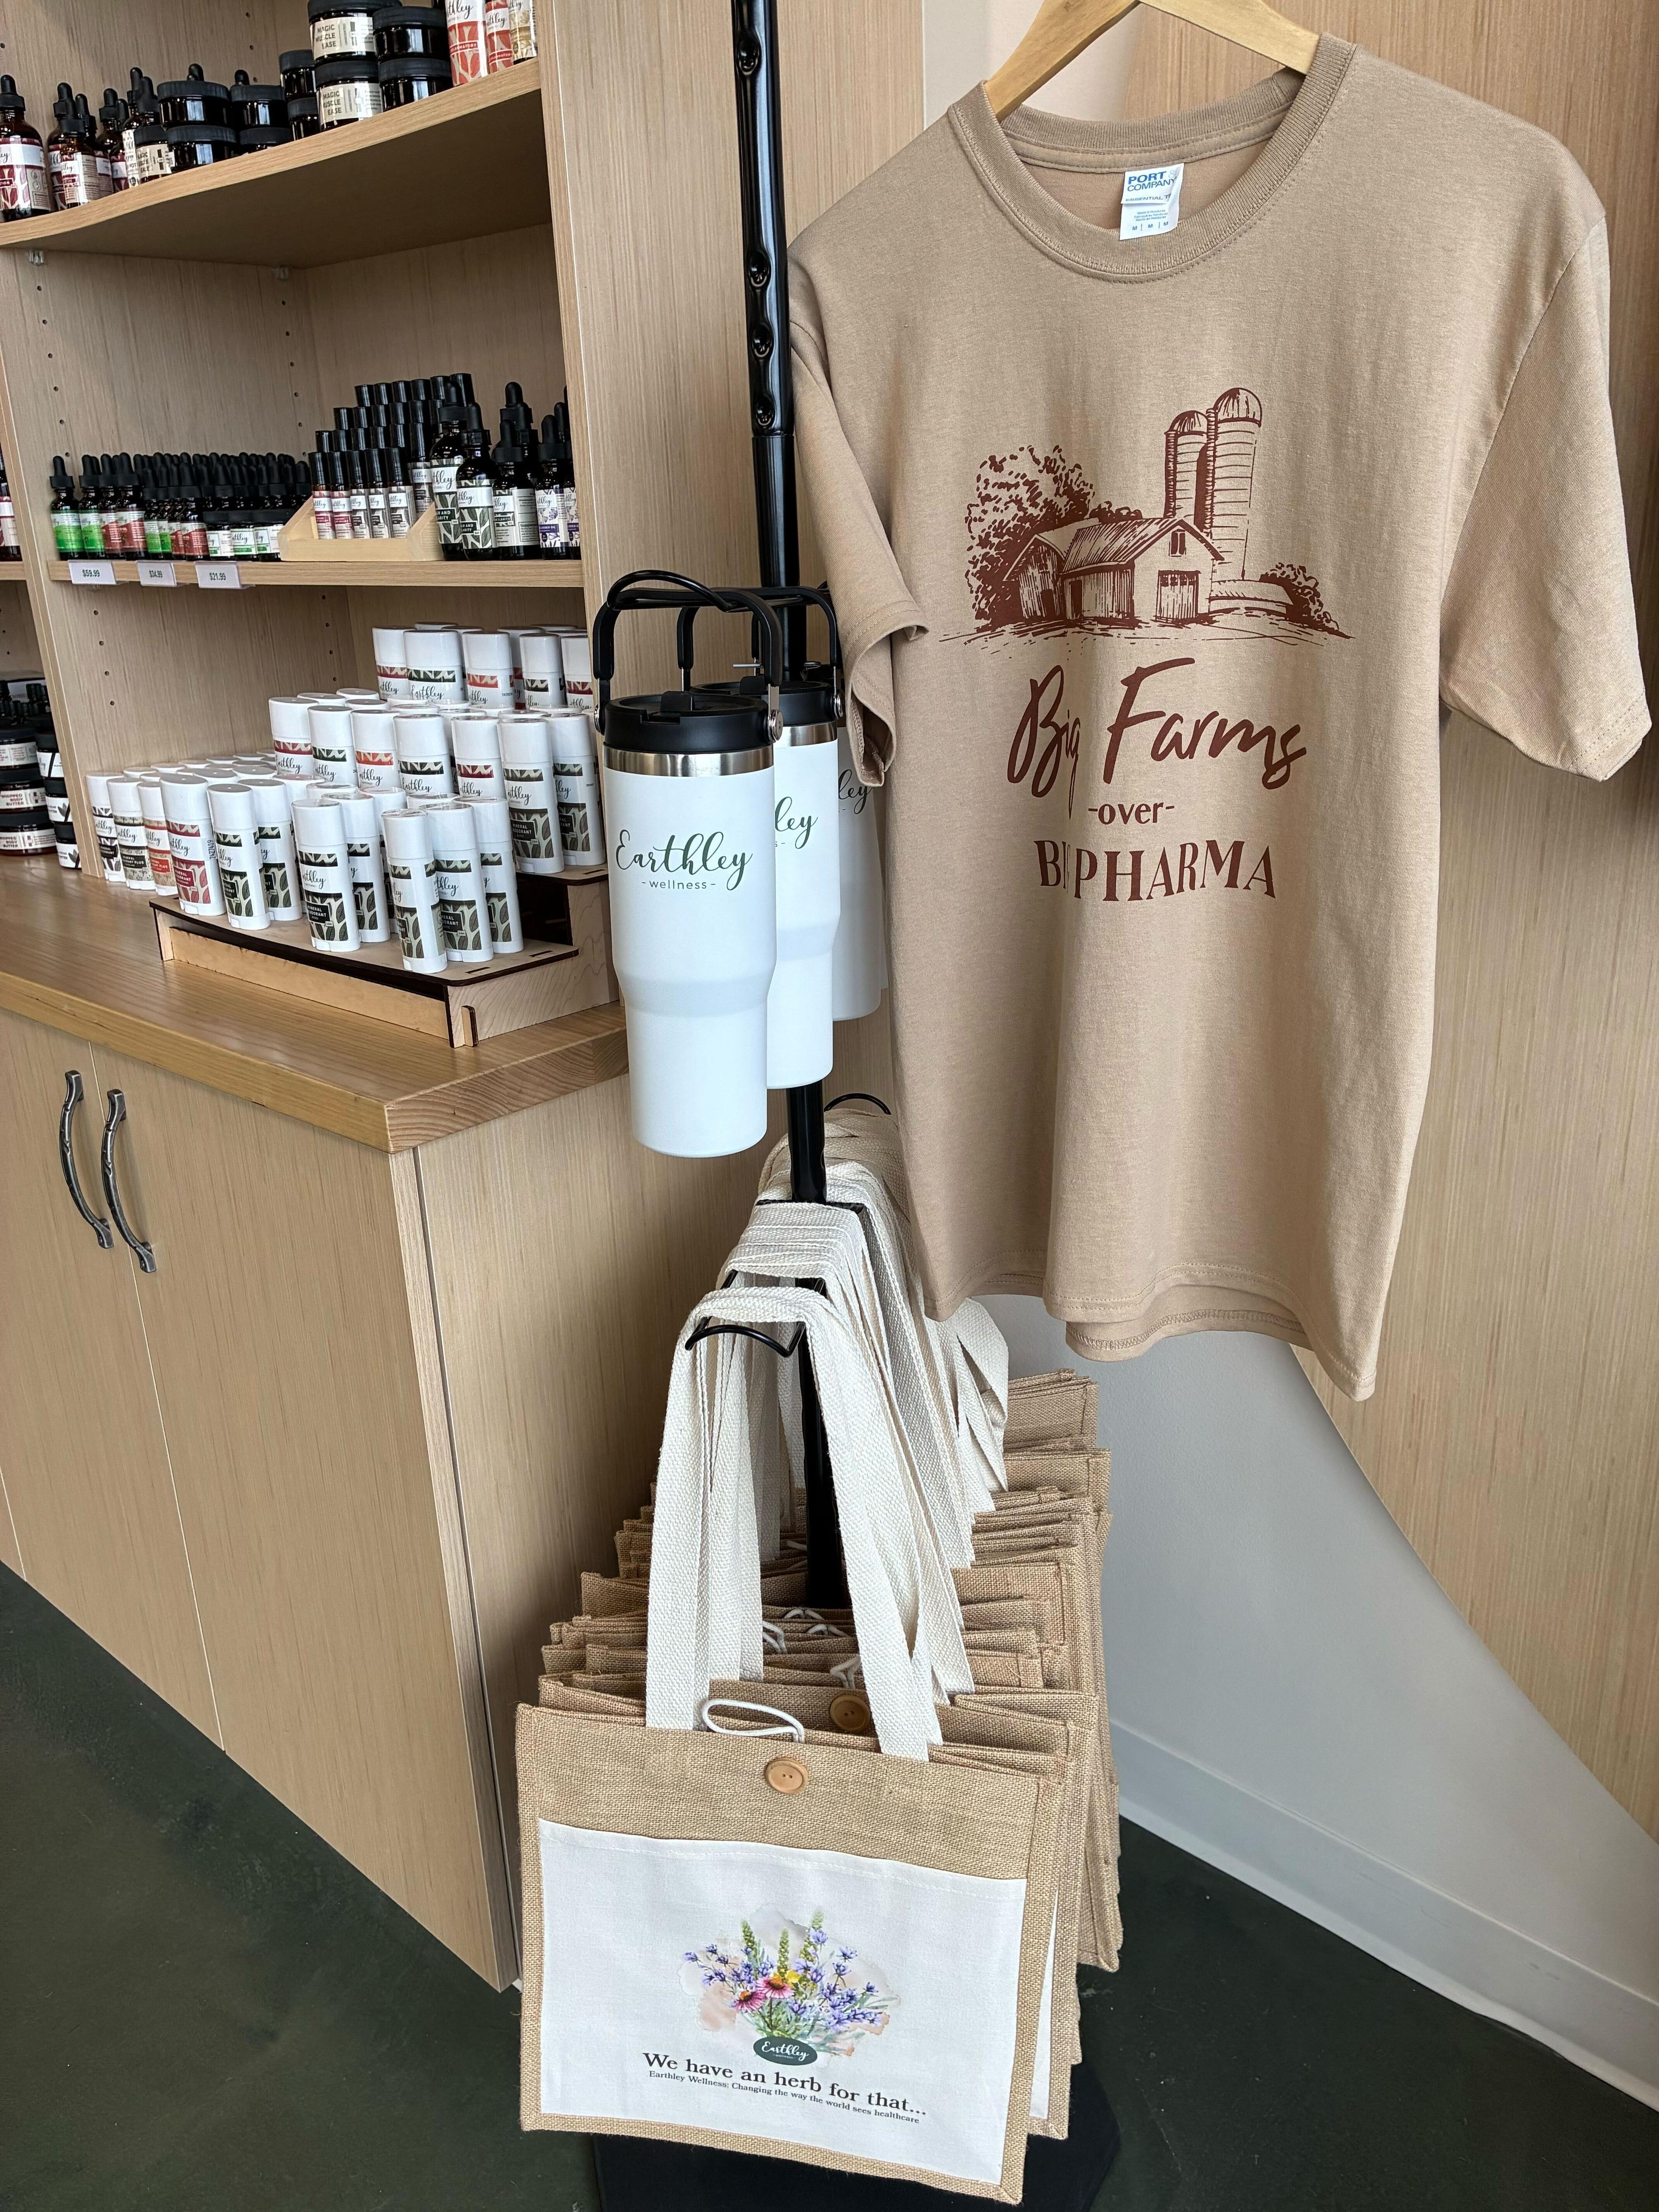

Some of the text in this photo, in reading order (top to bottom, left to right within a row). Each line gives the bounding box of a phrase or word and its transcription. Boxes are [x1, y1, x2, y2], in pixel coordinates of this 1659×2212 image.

[317, 24, 335, 33] MAGIC
[322, 41, 337, 49] EASE
[327, 108, 342, 116] EASE
[1127, 176, 1178, 192] COMPANY
[1128, 171, 1166, 184] PORT
[433, 470, 455, 489] thley
[149, 570, 163, 578] $34.99
[209, 572, 226, 581] $21.99
[1007, 658, 1307, 820] Big Farms
[615, 829, 753, 891] Earthley
[1074, 839, 1276, 901] PHARMA
[761, 2041, 810, 2061] Earthley
[642, 2053, 926, 2116] We have an herb for that...
[649, 2070, 686, 2082] Earthley
[731, 2082, 772, 2095] Changing
[810, 2095, 823, 2104] the
[825, 2101, 850, 2110] world
[852, 2107, 872, 2115] sees
[874, 2110, 920, 2124] healthcare
